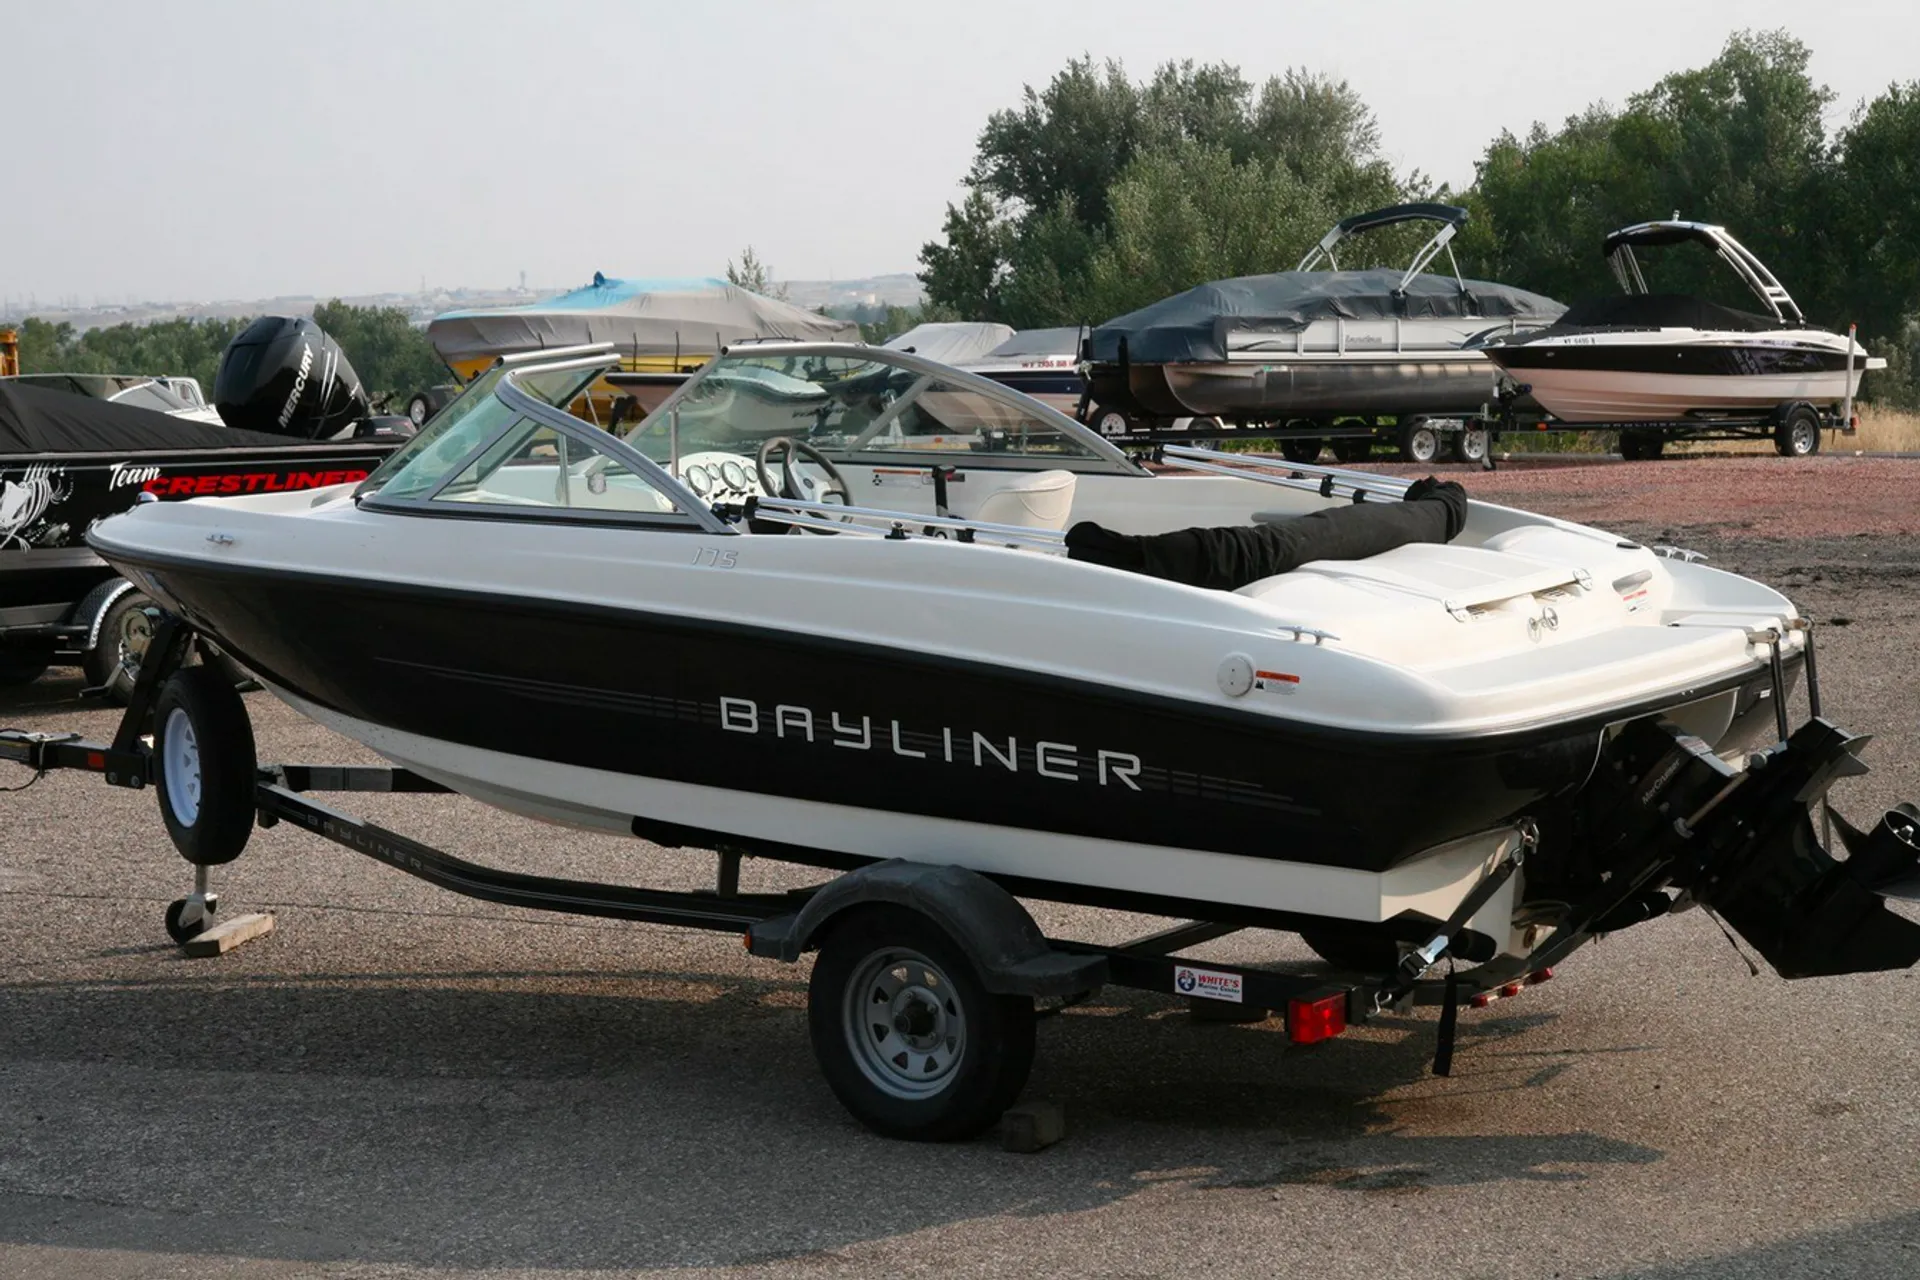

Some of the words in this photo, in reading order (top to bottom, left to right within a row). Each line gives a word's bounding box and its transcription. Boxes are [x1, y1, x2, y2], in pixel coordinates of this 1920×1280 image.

[278, 342, 314, 429] MERCURY
[109, 461, 161, 491] Team
[691, 547, 739, 570] 175
[720, 696, 1142, 791] BAYLINER
[307, 814, 424, 870] BAYLINER
[1198, 975, 1240, 988] WHITE'S
